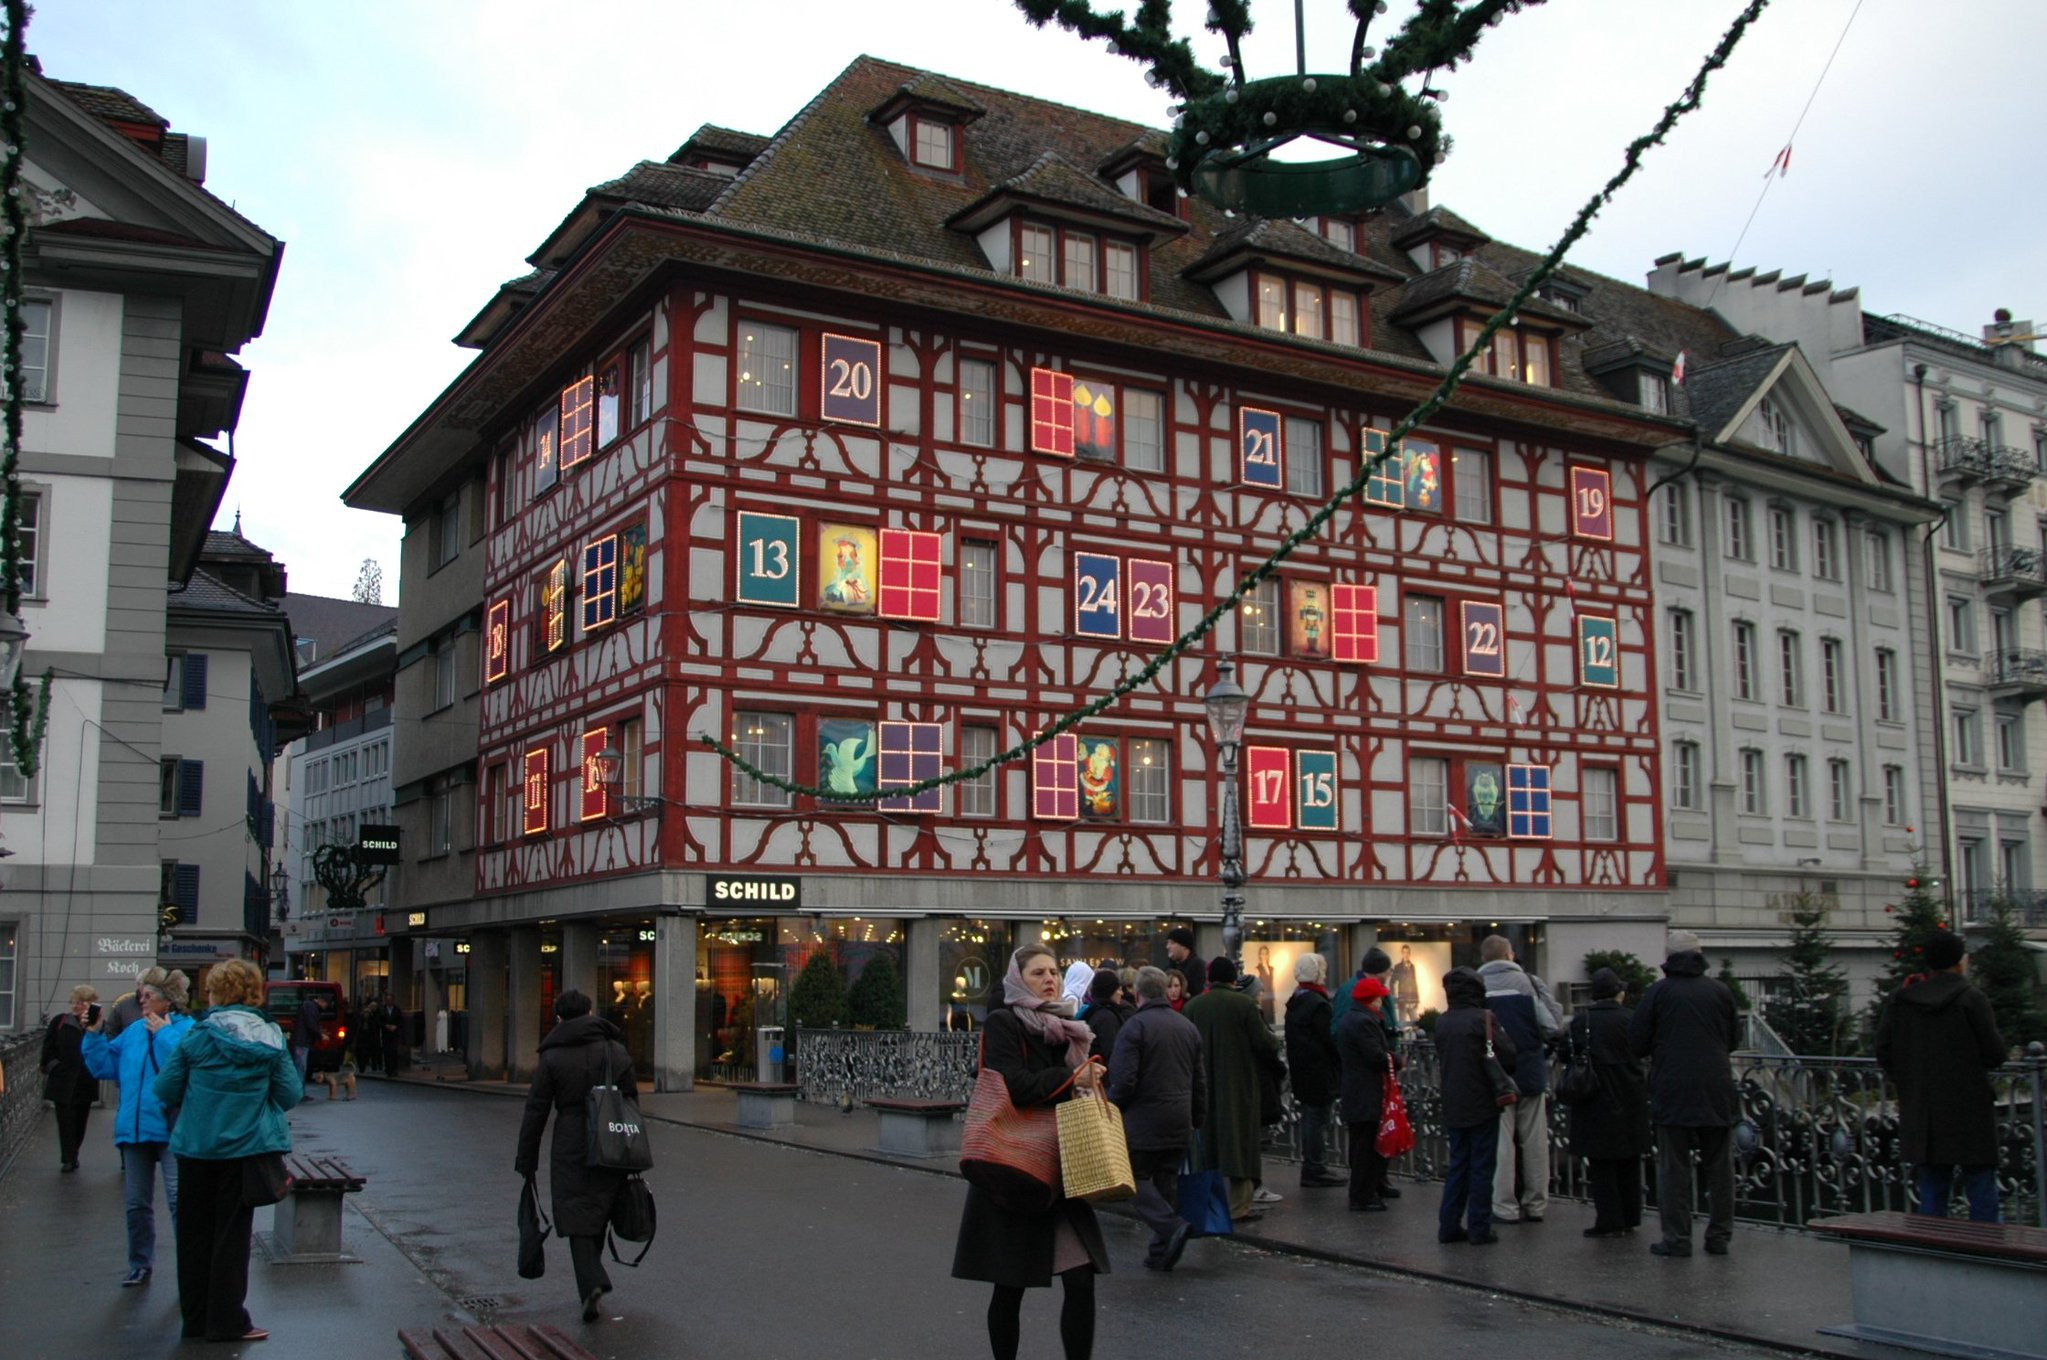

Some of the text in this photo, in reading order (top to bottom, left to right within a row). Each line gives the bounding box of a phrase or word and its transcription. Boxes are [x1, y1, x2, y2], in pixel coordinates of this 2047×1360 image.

[830, 358, 872, 400] 20
[539, 431, 551, 469] 14
[1246, 429, 1276, 465] 21
[1578, 488, 1604, 518] 19
[749, 538, 789, 579] 13
[1079, 575, 1117, 614] 24
[1133, 581, 1169, 619] 23
[492, 623, 502, 659] 18
[1469, 622, 1498, 656] 22
[1586, 635, 1612, 667] 12
[586, 754, 600, 793] 16
[1254, 769, 1284, 804] 17
[1302, 773, 1332, 807] 15
[530, 773, 540, 810] 11
[362, 841, 398, 849] SCHILD
[715, 881, 795, 900] SCHILD
[98, 938, 150, 952] Bäckerei
[106, 960, 139, 975] Koch
